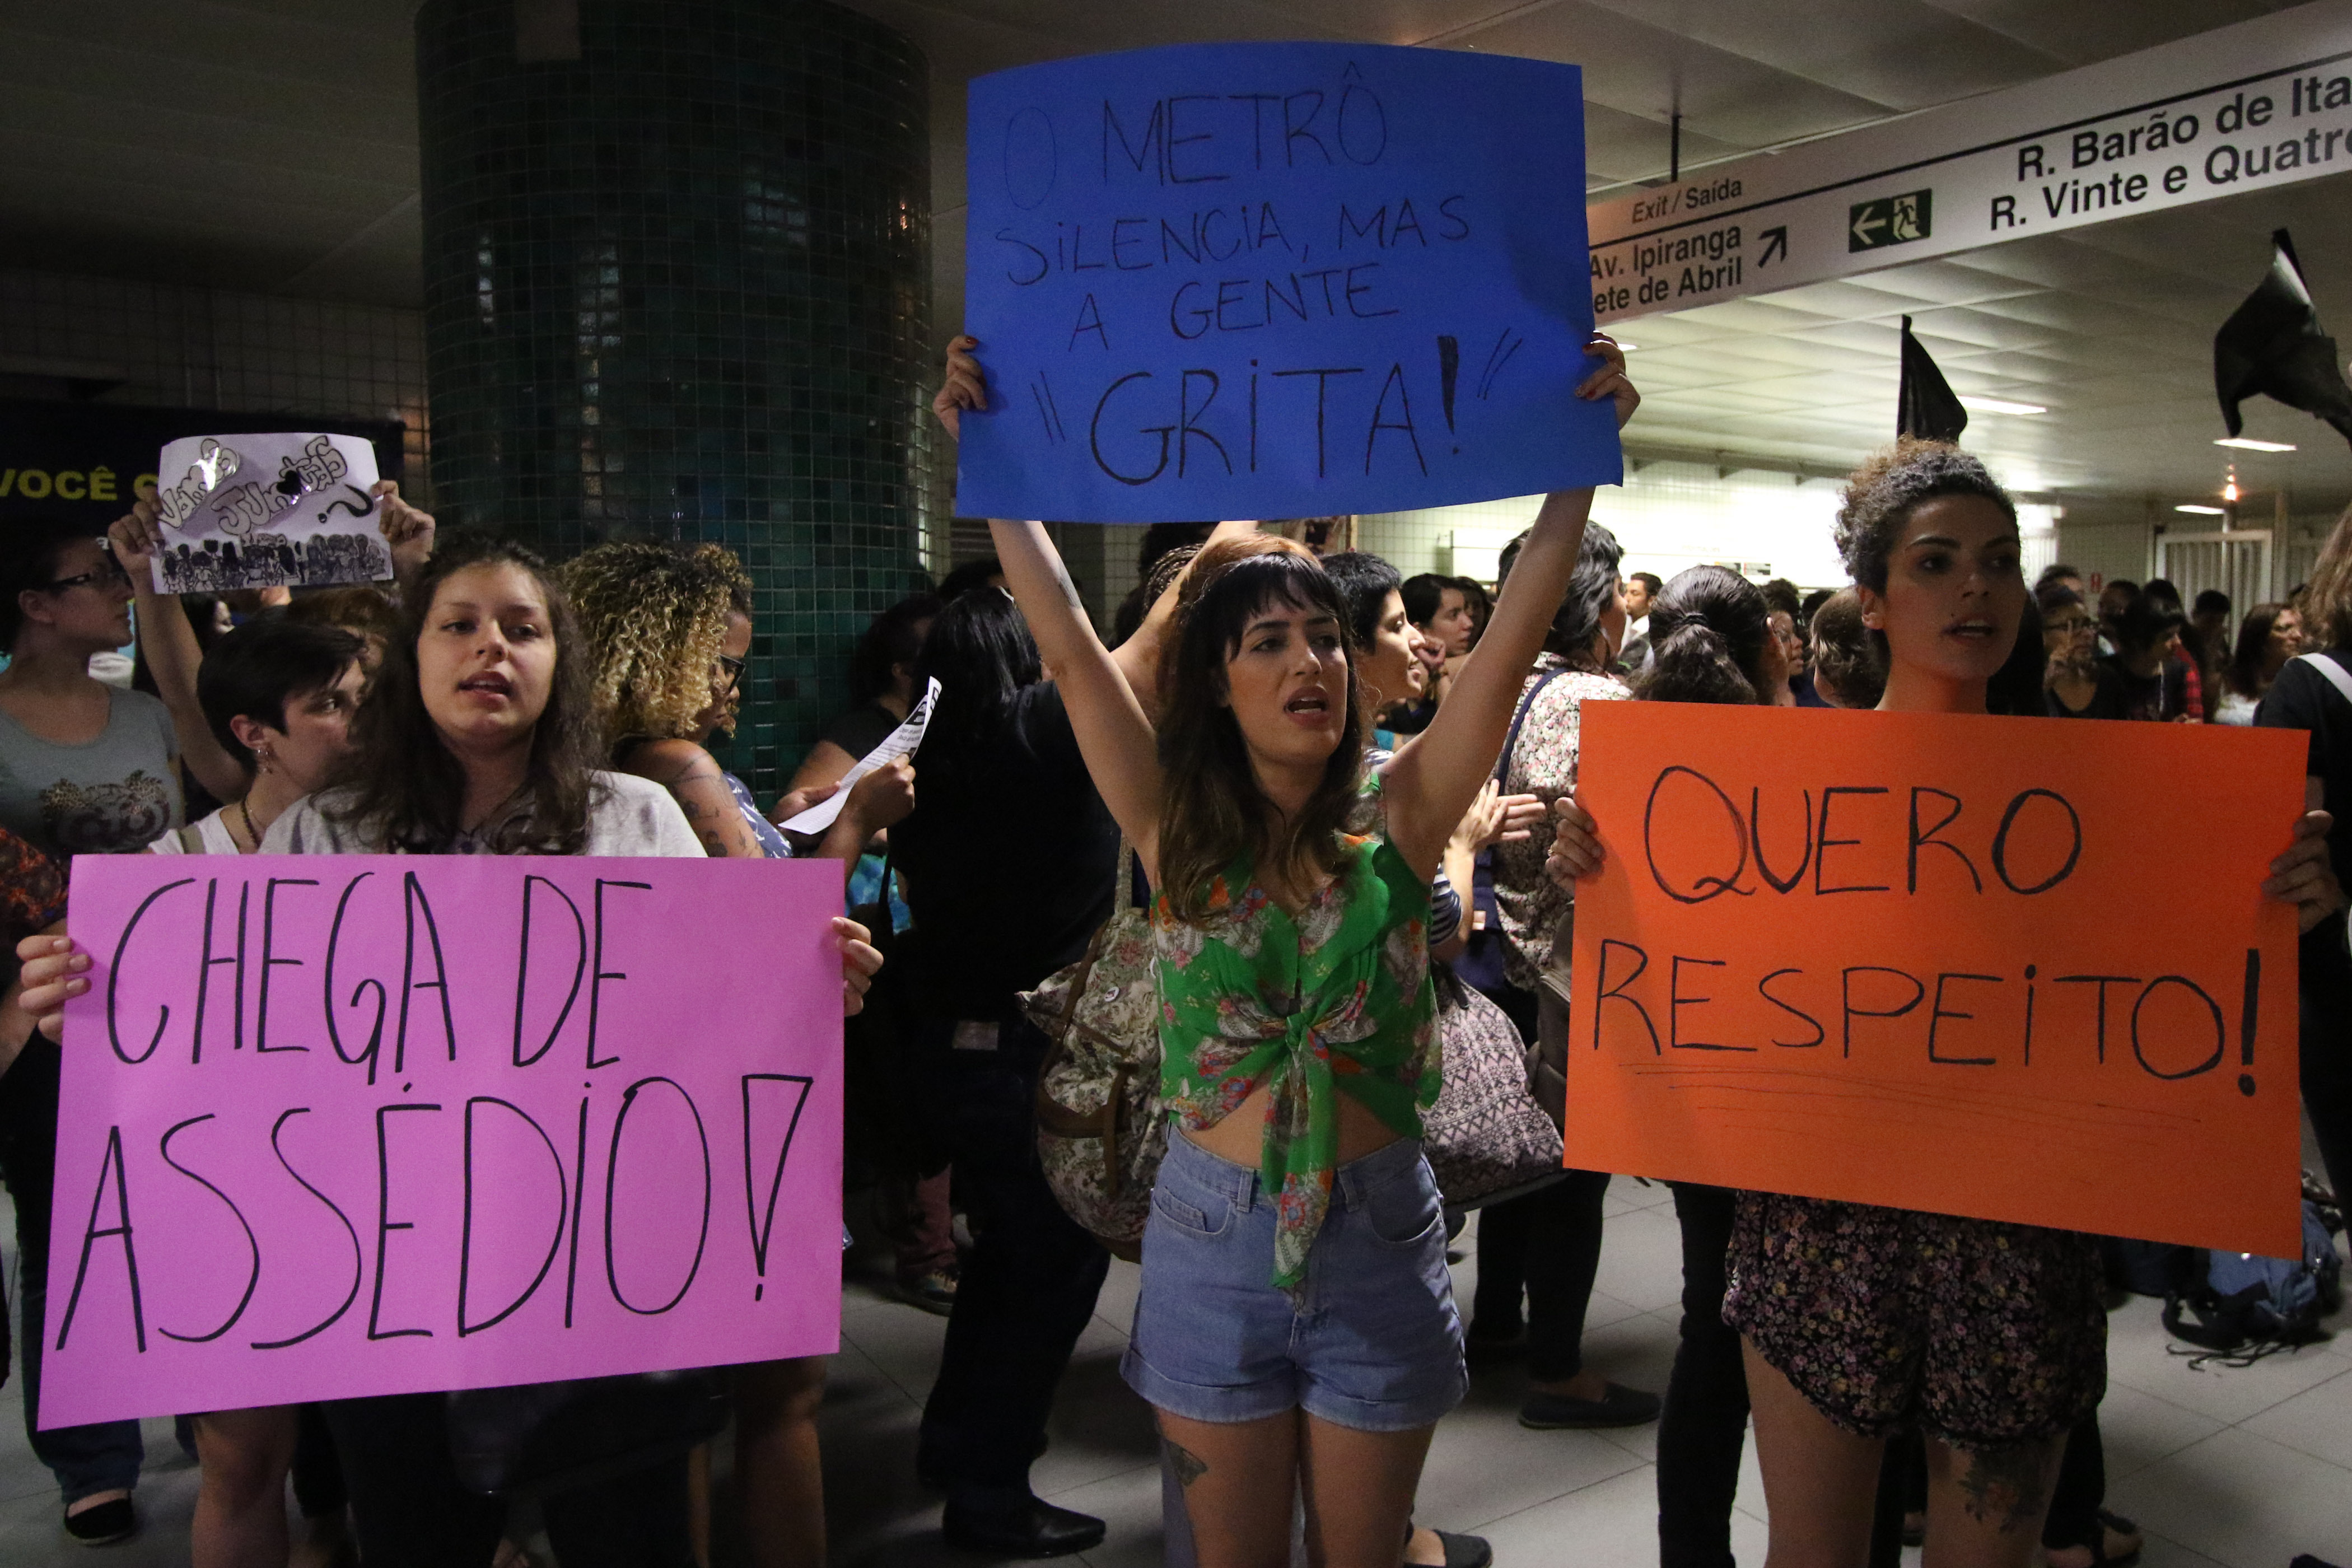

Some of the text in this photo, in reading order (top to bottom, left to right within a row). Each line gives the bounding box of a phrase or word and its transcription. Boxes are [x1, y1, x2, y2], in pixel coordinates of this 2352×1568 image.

[1005, 61, 1387, 210] O METRÔ
[2017, 76, 2352, 181] R. Barão de Ita
[1338, 195, 1471, 251] MAS
[1631, 195, 1669, 225] Exit
[1685, 178, 1743, 210] Saída
[1990, 128, 2352, 231] R. Vinte e Quatr
[1590, 226, 1742, 279] Av. Ipiranga
[1638, 277, 1669, 305] de
[1678, 256, 1742, 297] Abril
[1068, 263, 1400, 352] A GENTE
[1643, 766, 2083, 904] QUERO
[107, 870, 653, 1086] CHEGA DE
